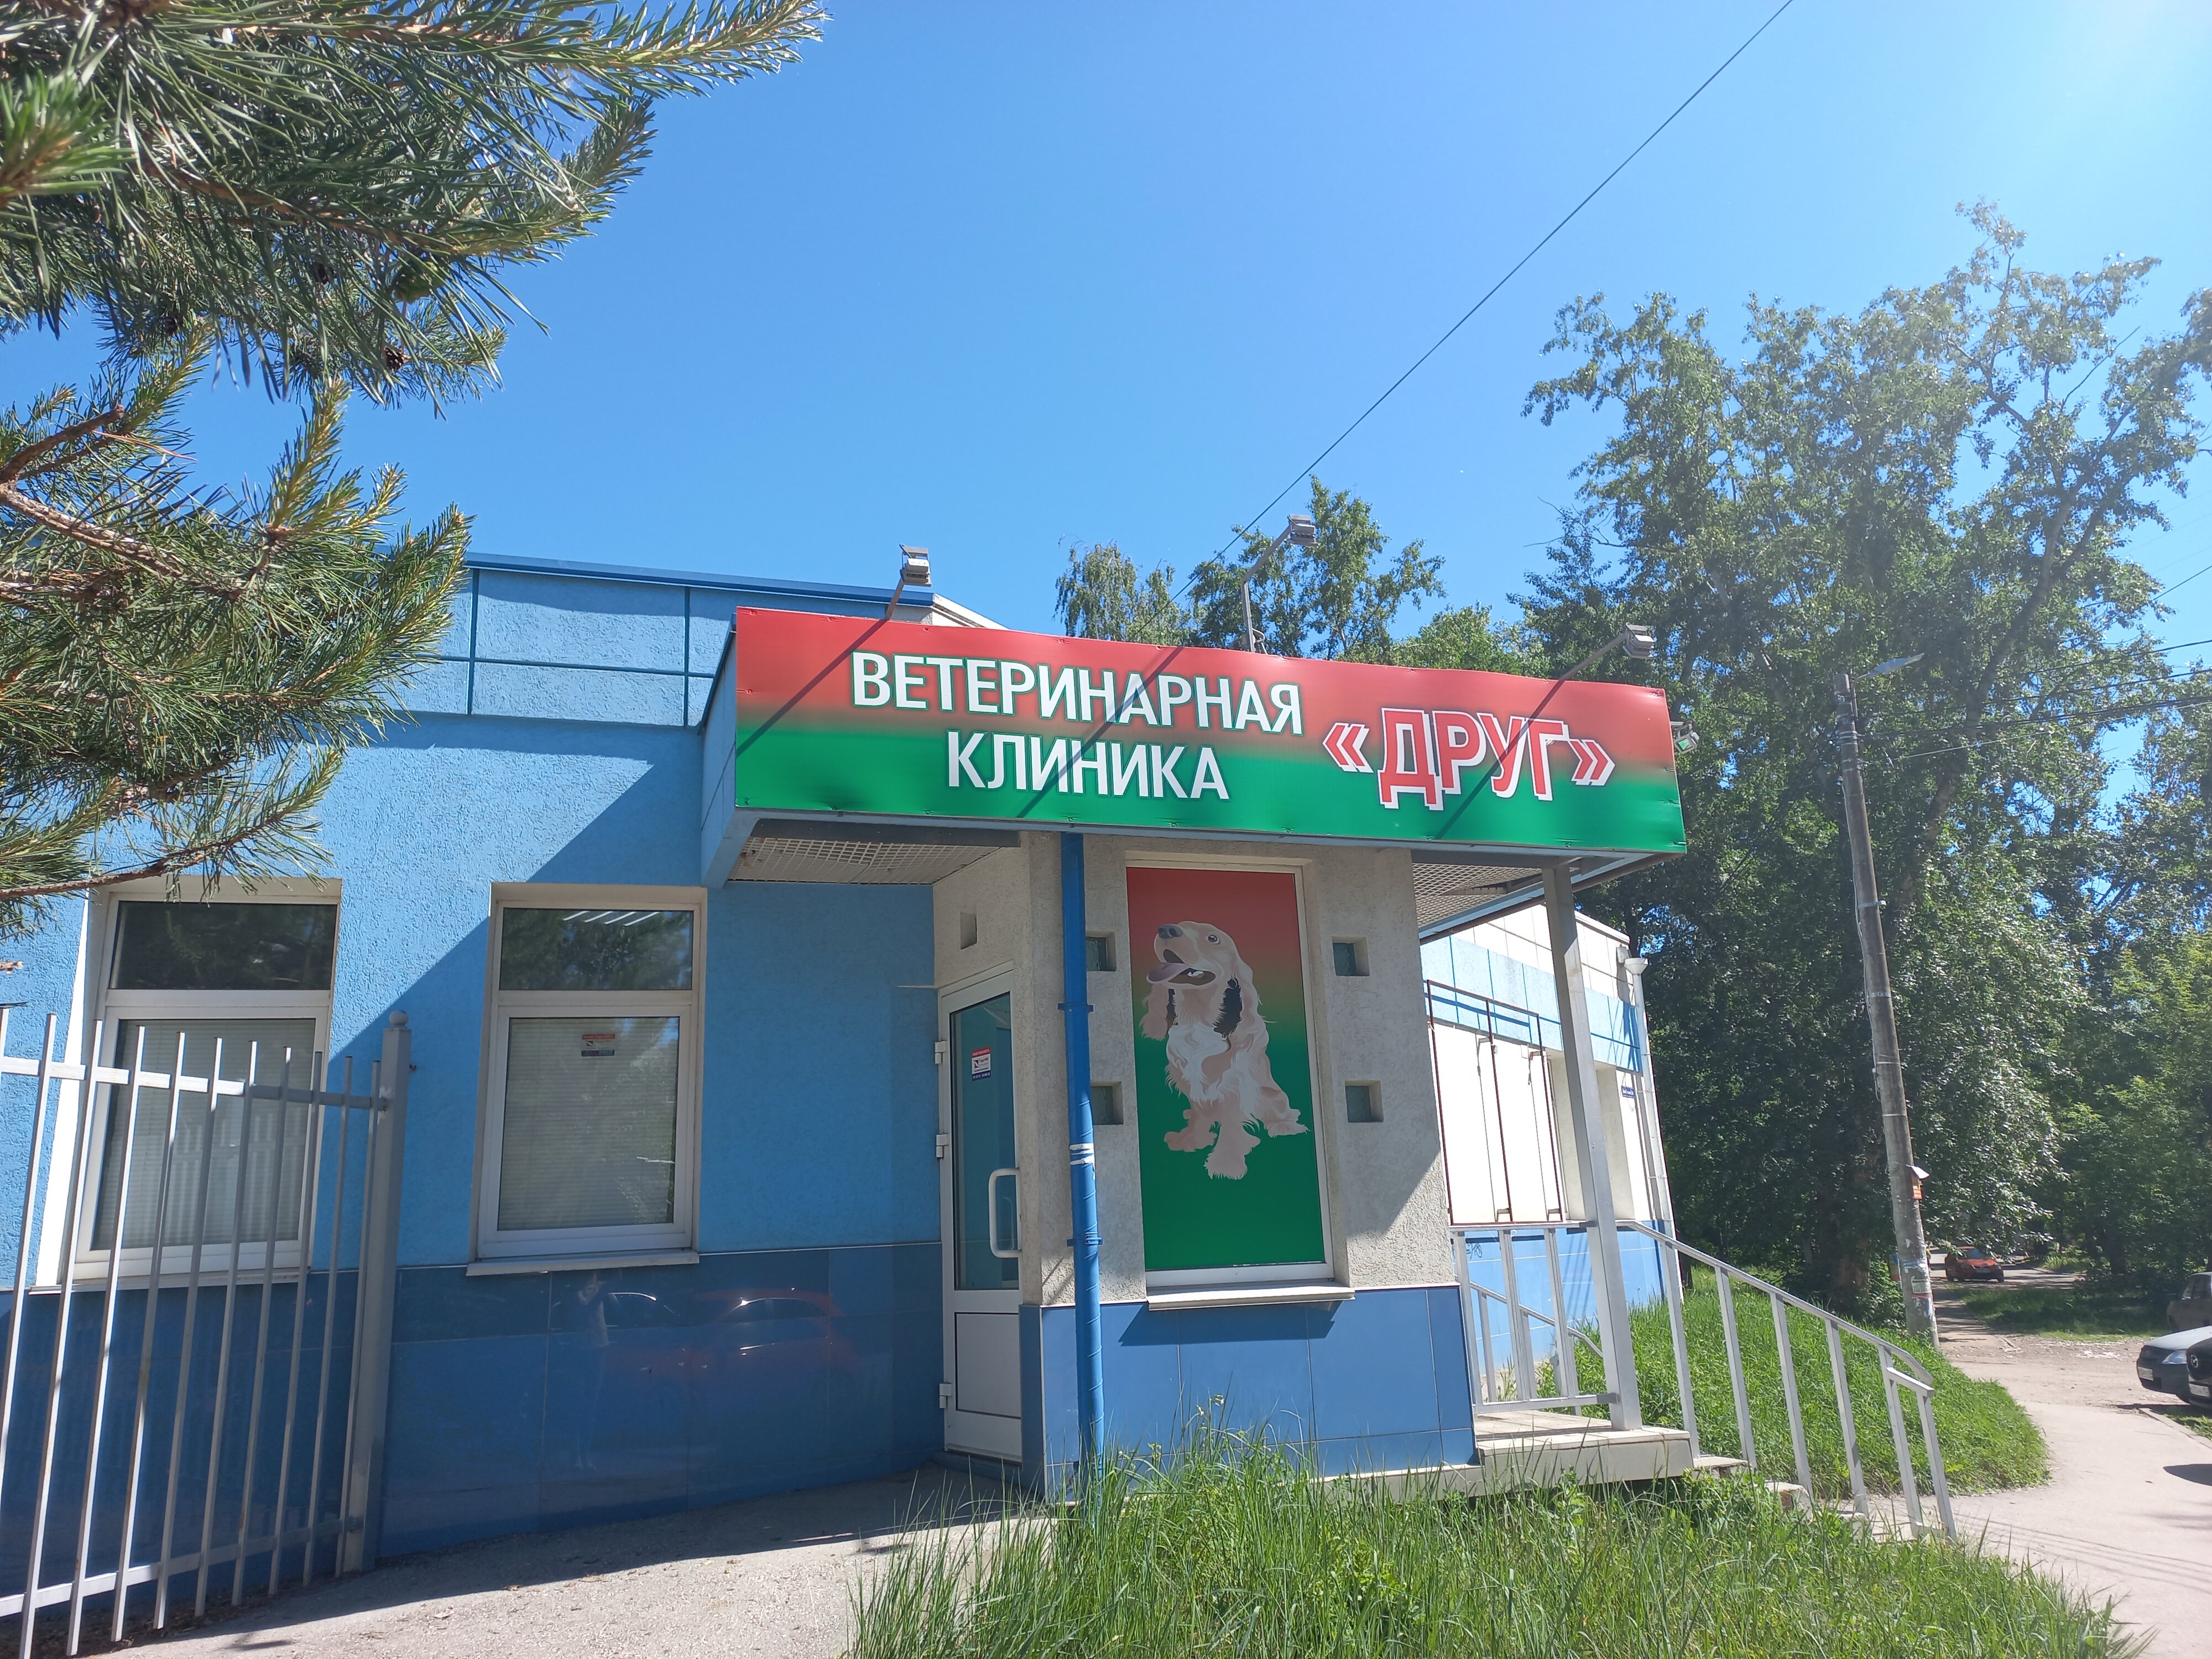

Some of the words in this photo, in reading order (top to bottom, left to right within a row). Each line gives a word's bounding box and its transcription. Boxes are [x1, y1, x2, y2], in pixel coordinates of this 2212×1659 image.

[852, 651, 1302, 735] ВЕТЕРИНАРНАЯ
[947, 731, 1230, 800] КЛИНИКА
[1322, 707, 1616, 811] «ДРУГ»
